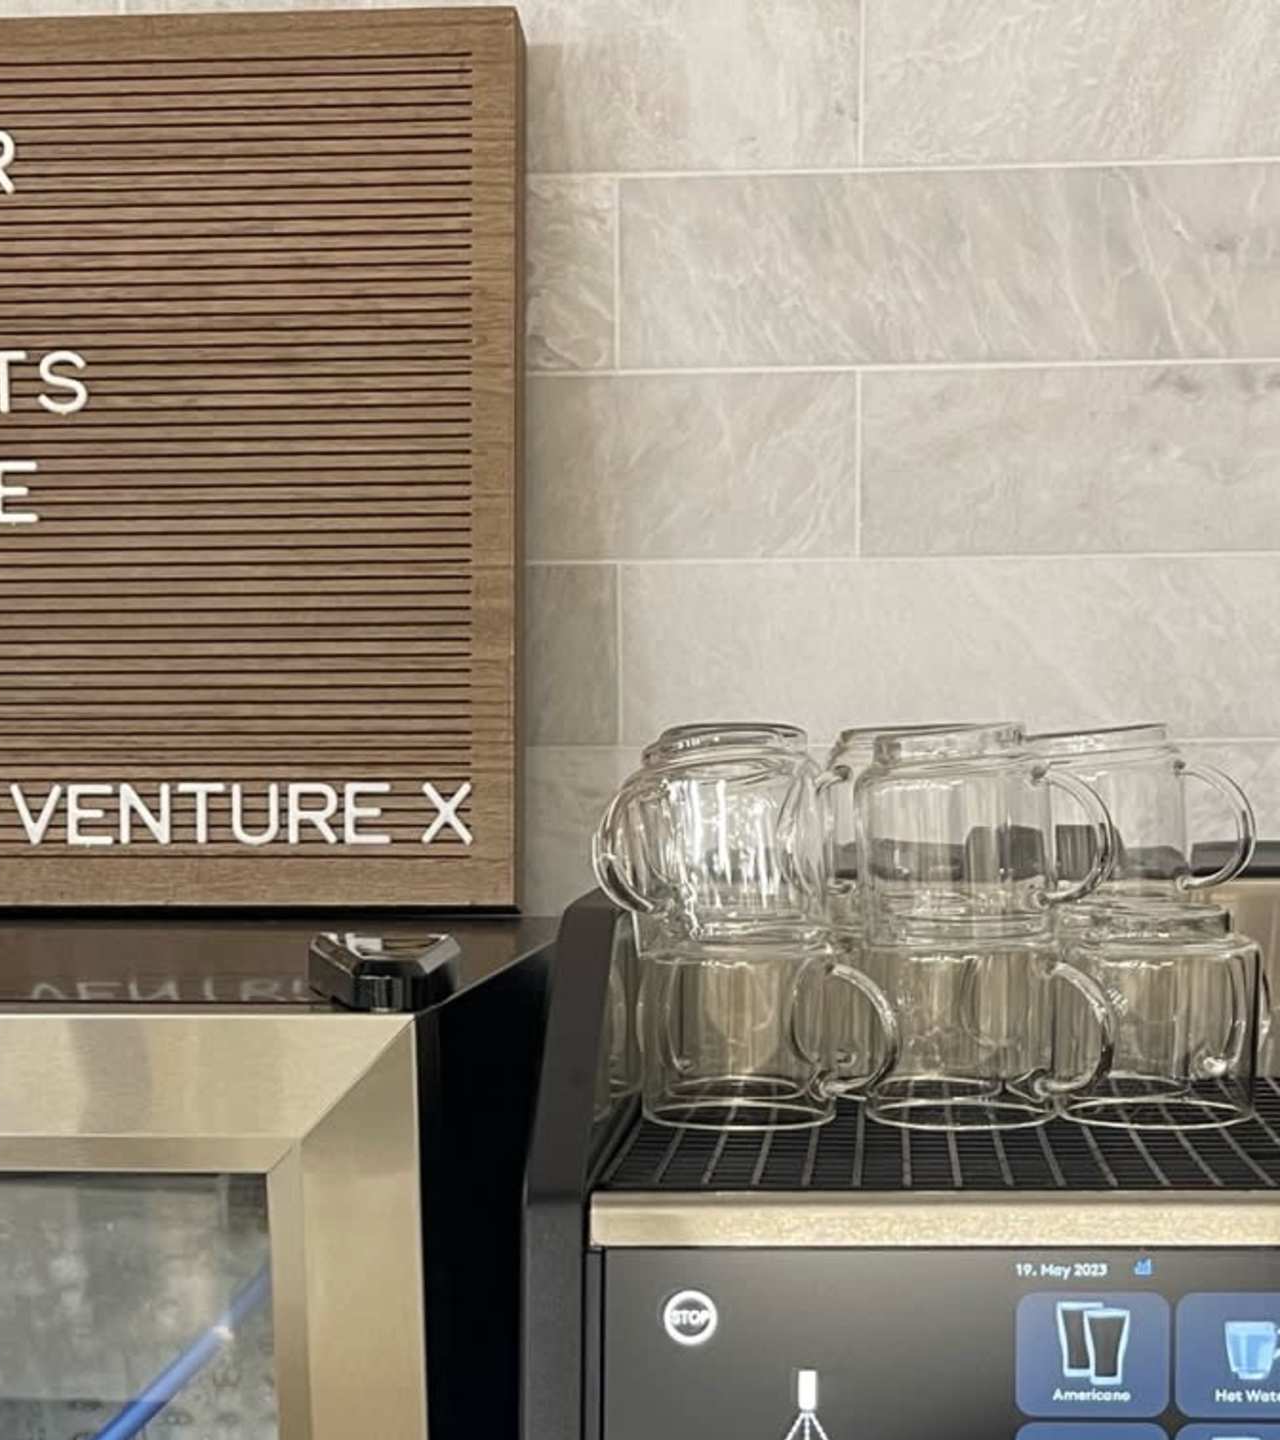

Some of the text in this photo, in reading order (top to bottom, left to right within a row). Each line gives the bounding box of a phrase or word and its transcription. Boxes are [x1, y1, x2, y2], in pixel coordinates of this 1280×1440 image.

[9, 782, 473, 845] VENTURE X
[1016, 1263, 1108, 1280] 19. May 2023
[671, 1309, 711, 1326] STOP
[1052, 1388, 1131, 1402] Americano
[1215, 1389, 1242, 1402] Hot
